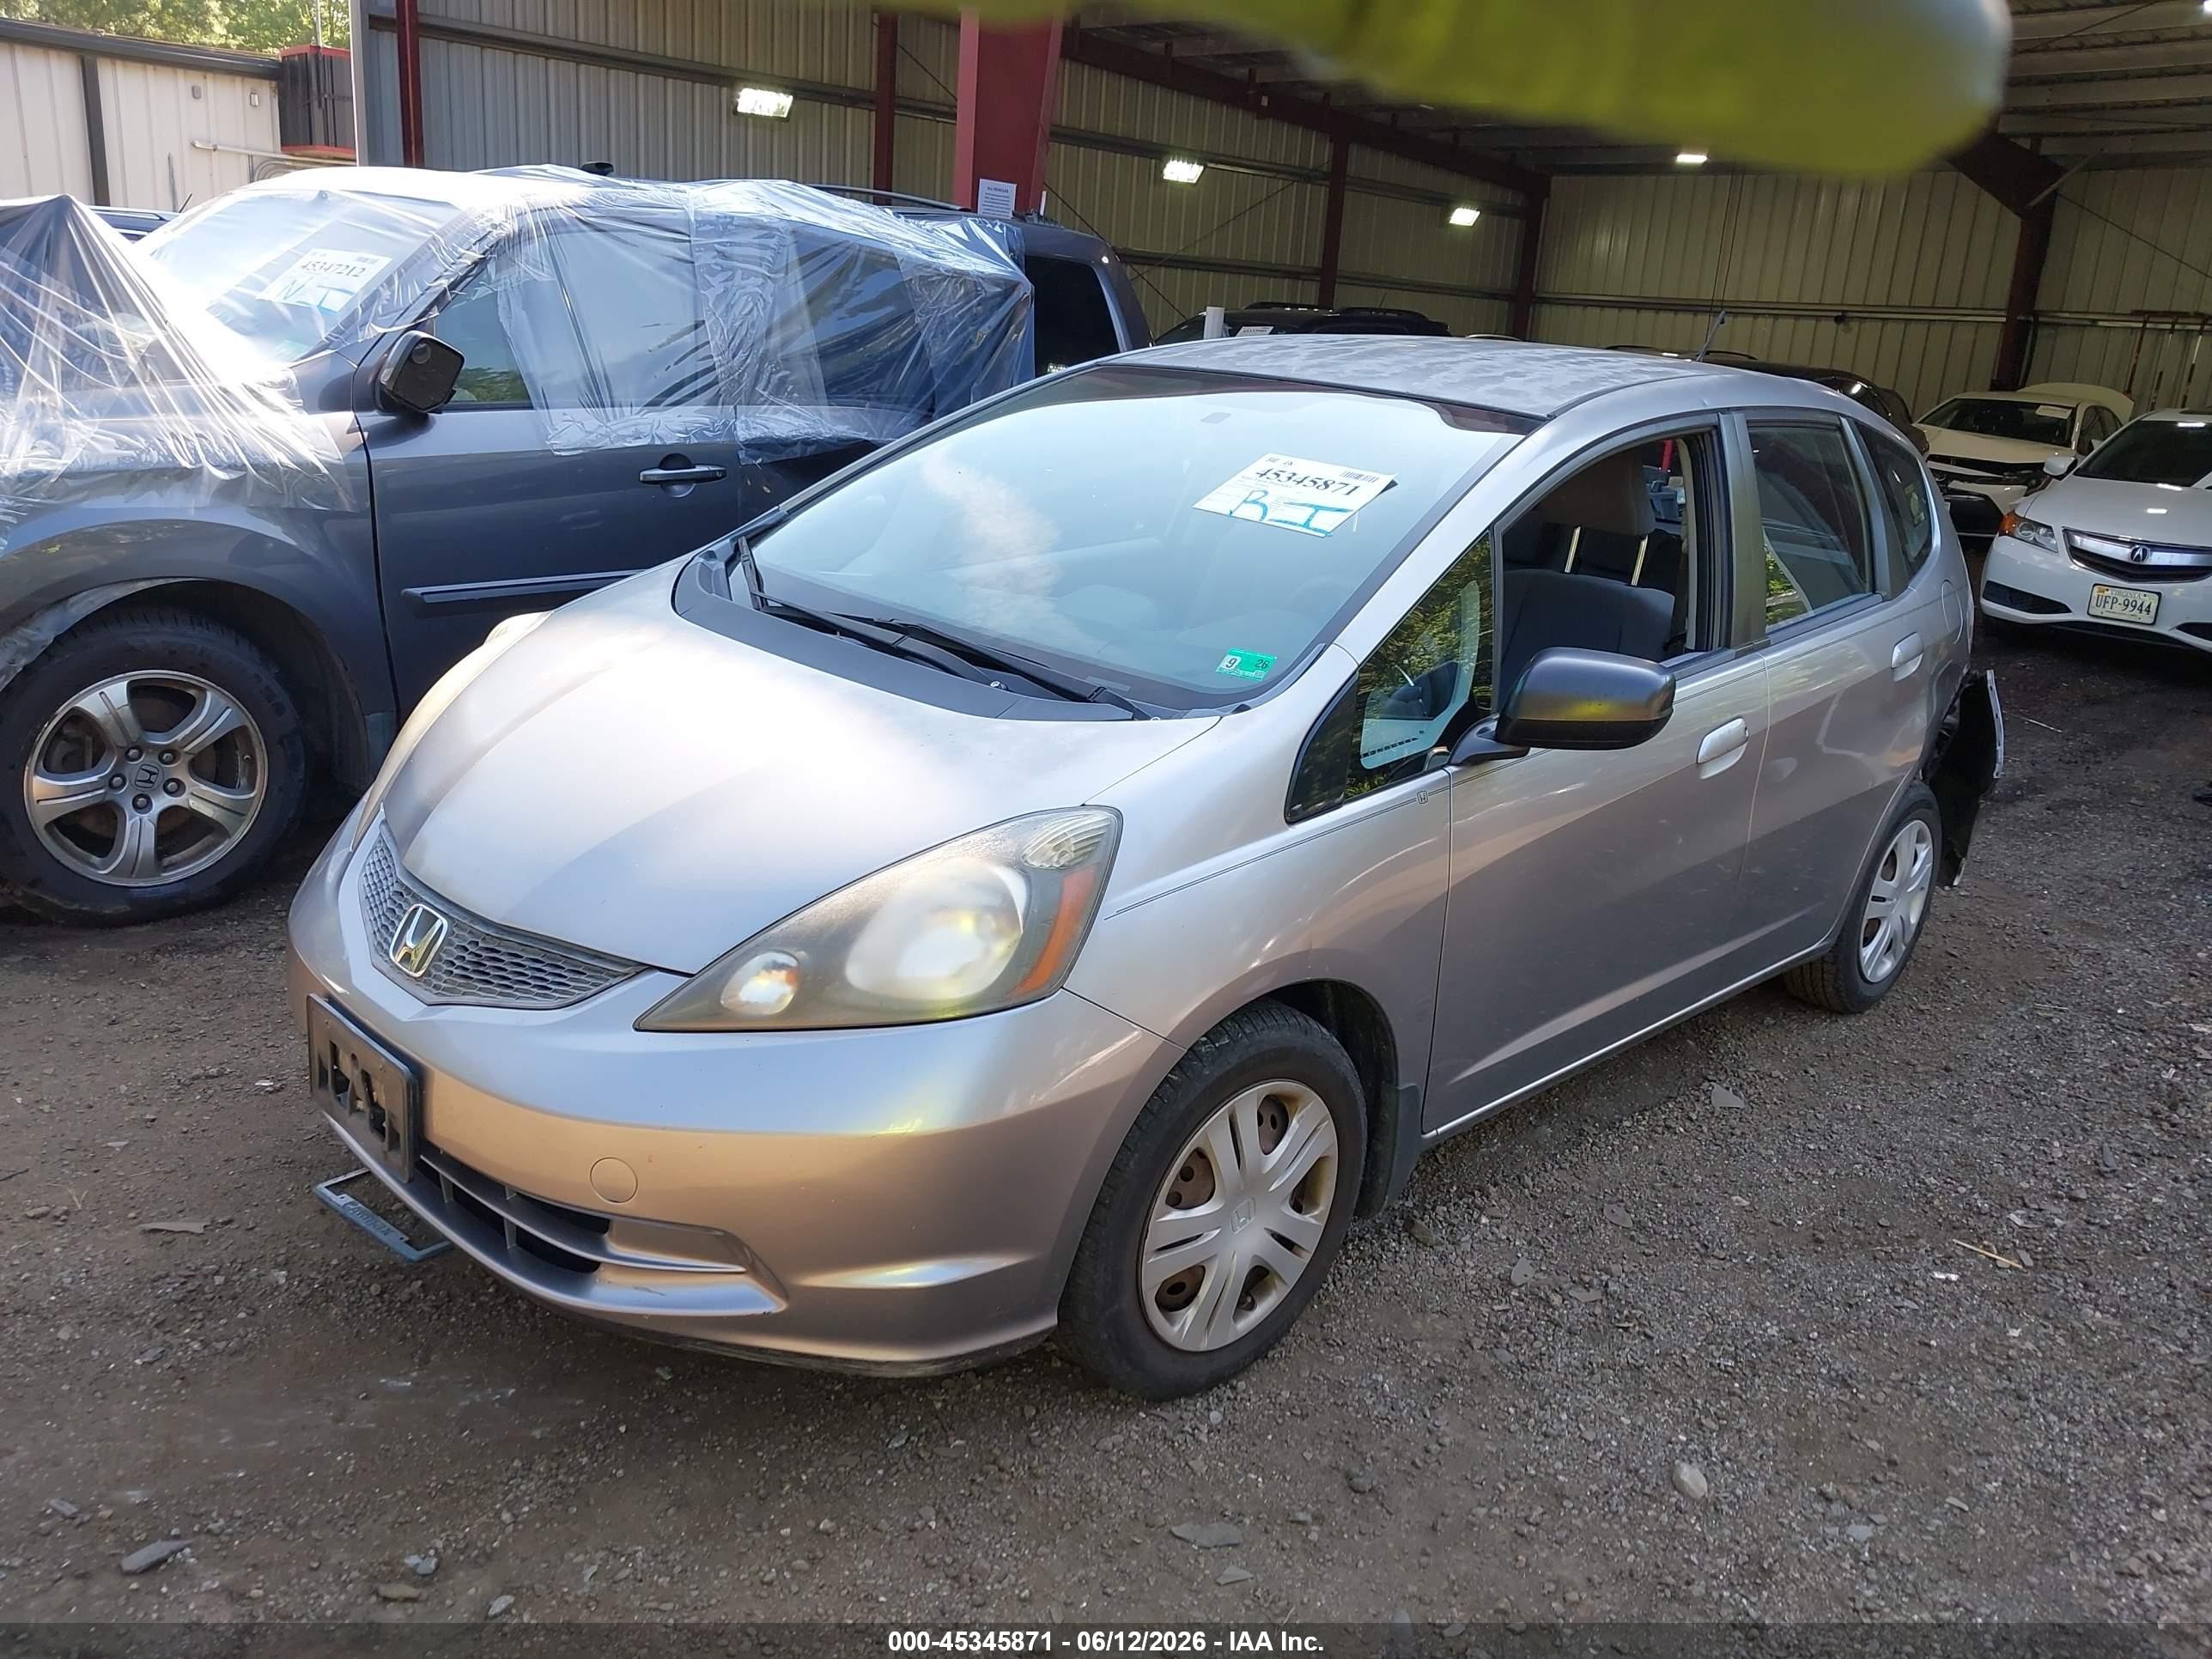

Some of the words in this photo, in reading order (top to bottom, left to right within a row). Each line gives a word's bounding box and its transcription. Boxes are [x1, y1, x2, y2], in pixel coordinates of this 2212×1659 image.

[301, 261, 367, 277] 45347212
[1255, 467, 1361, 496] 45345871
[2110, 589, 2142, 599] VIRGINIA
[2095, 594, 2153, 616] UFP-9944
[1225, 658, 1237, 668] 9
[1255, 659, 1270, 669] 26
